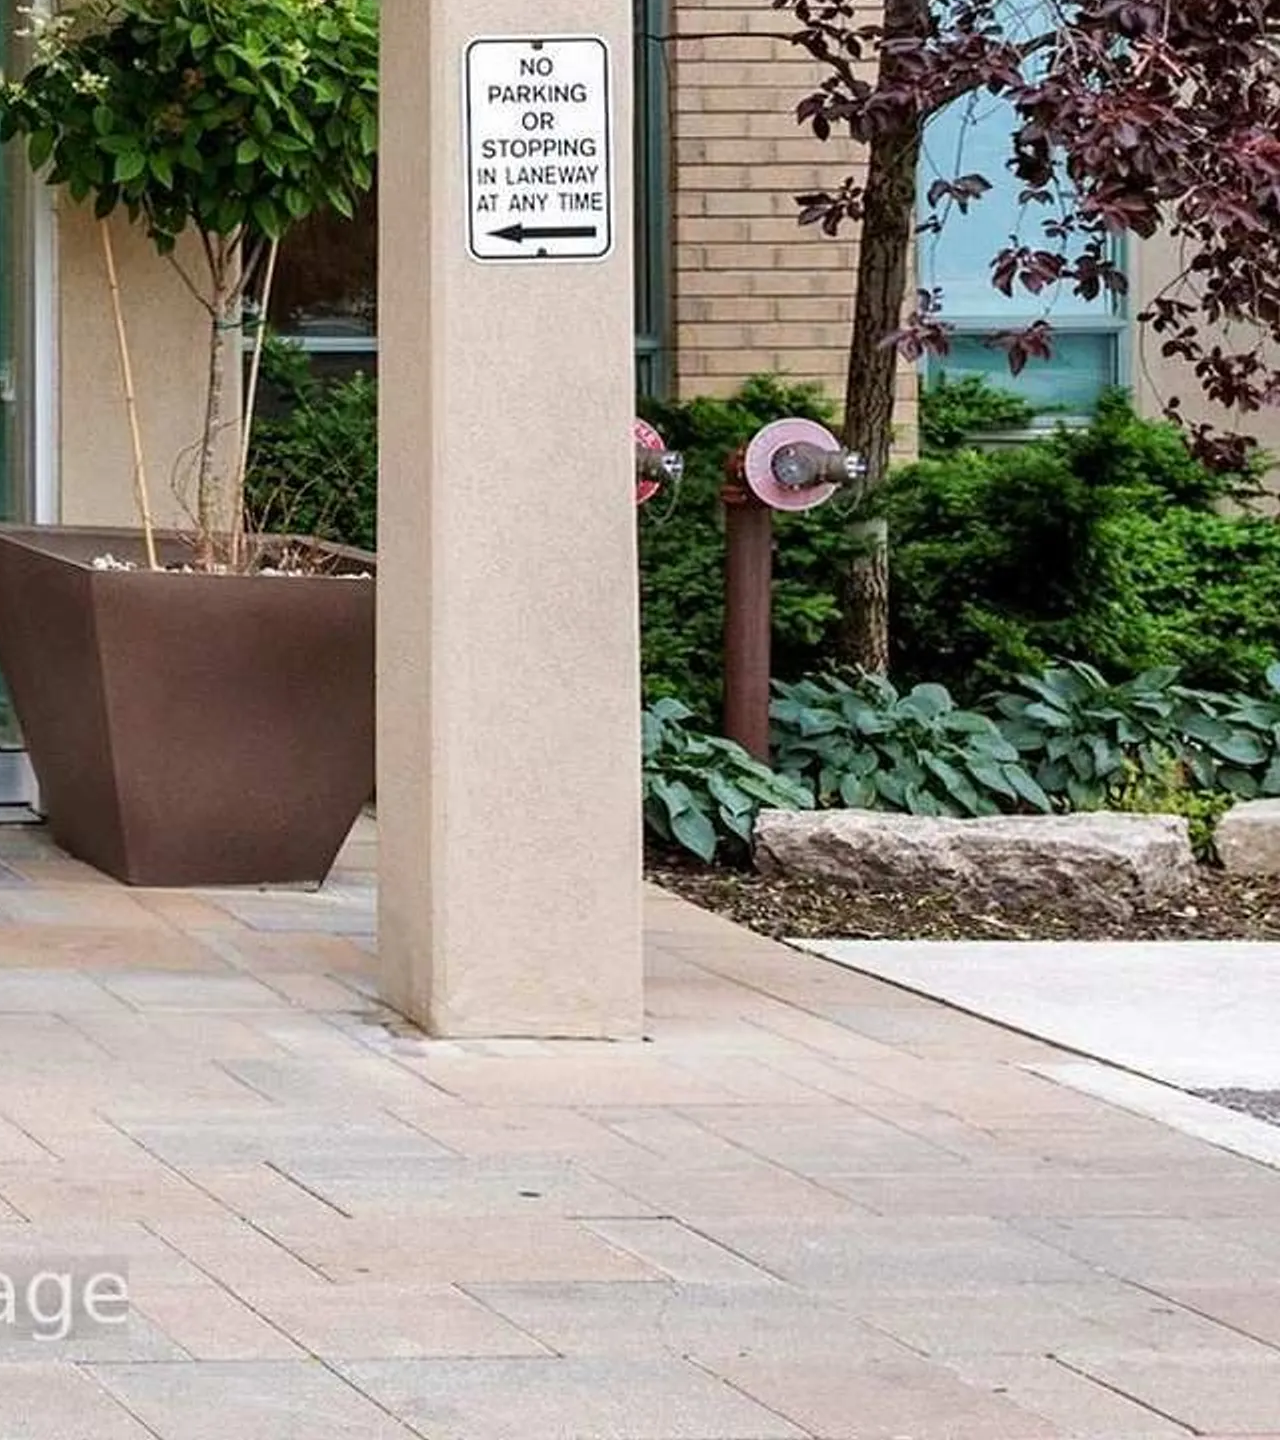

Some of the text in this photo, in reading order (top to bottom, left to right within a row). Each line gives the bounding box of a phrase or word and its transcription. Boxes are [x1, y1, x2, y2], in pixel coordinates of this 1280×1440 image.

[520, 57, 553, 76] NO
[488, 84, 587, 104] PARKING
[521, 112, 554, 131] OR
[482, 138, 596, 159] STOPPING
[478, 165, 598, 185] IN LANEWAY
[477, 192, 603, 211] AT ANY TIME
